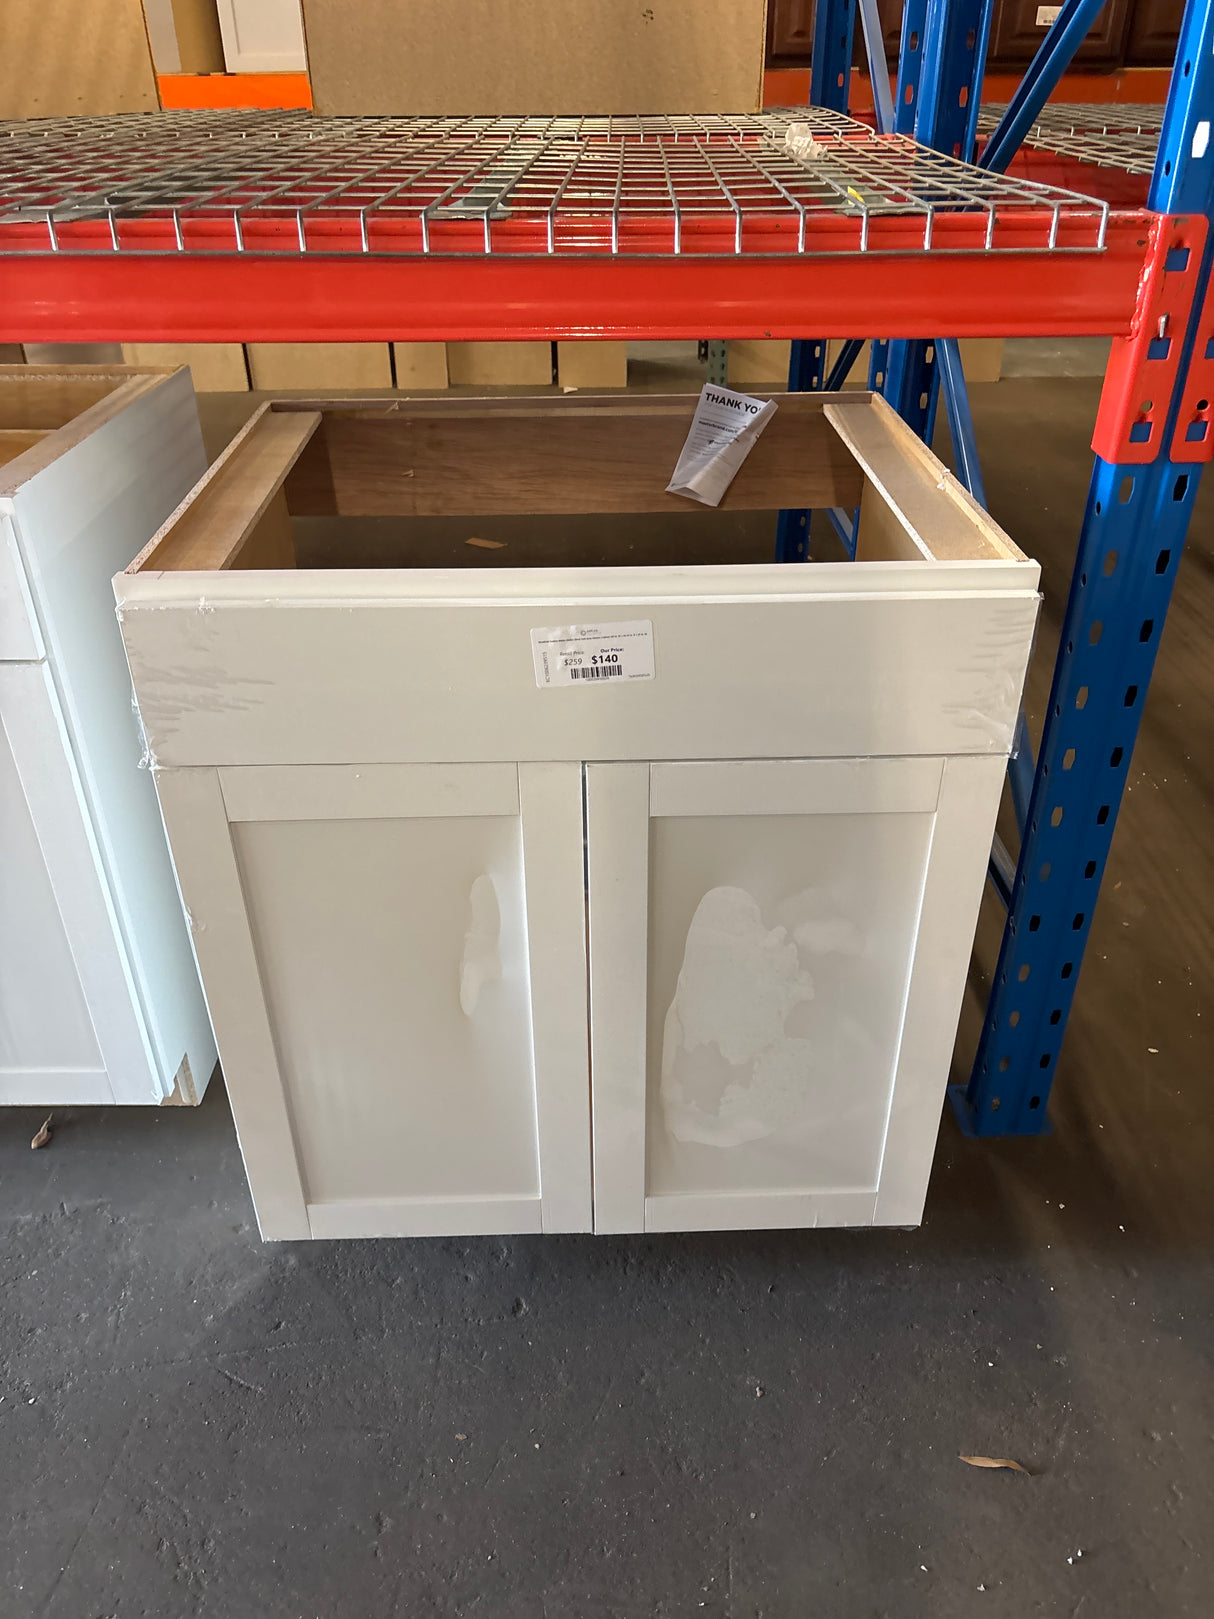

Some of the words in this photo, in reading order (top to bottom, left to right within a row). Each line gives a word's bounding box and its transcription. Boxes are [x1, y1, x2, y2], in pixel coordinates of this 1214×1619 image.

[706, 393, 742, 409] THANK
[744, 403, 761, 414] YO
[564, 658, 583, 666] $259
[592, 654, 618, 664] $140
